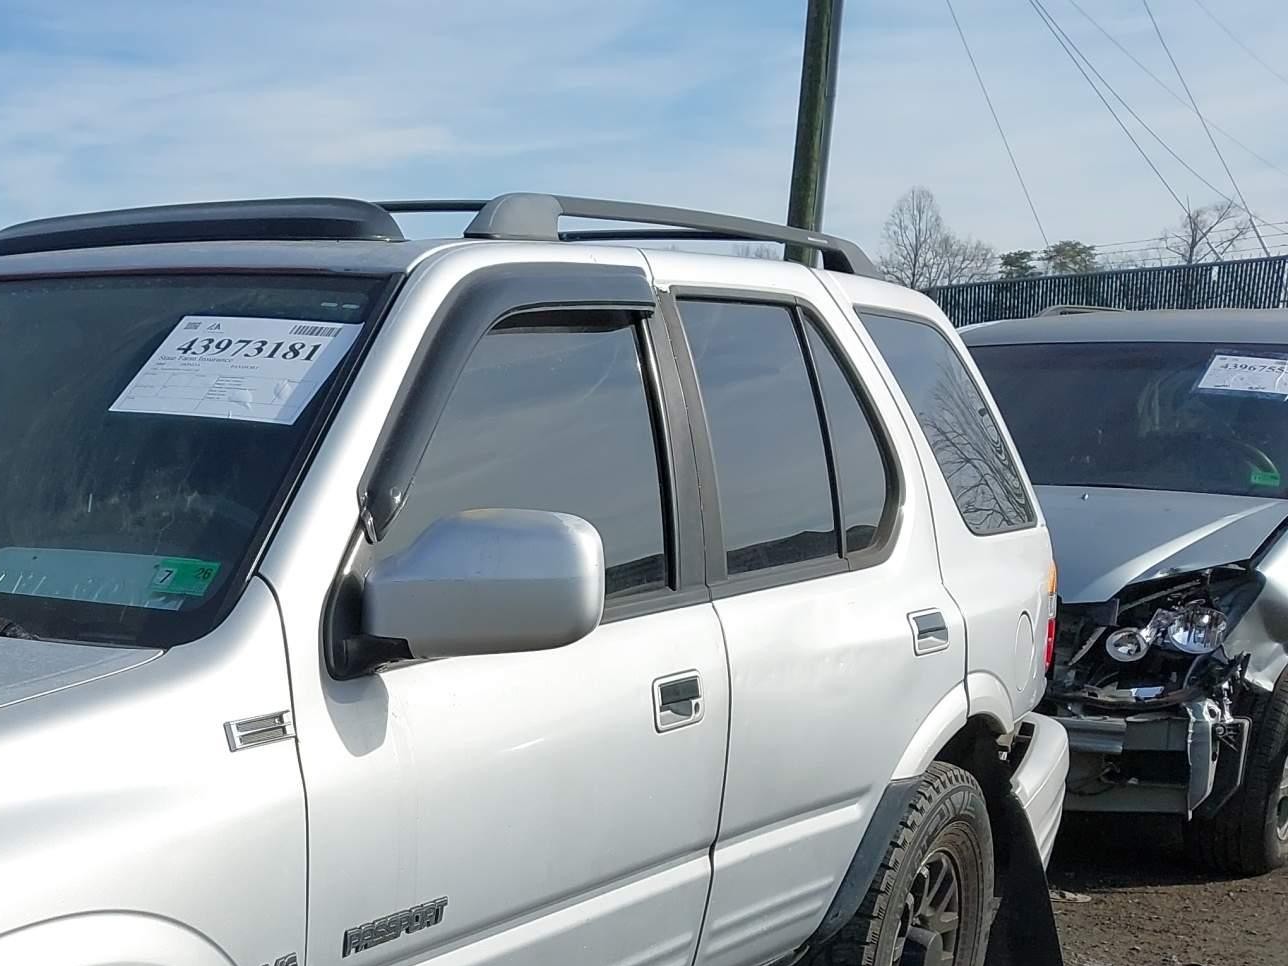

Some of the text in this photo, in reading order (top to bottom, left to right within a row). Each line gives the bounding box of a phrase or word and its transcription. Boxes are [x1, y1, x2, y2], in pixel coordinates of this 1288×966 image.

[176, 336, 322, 362] 43973181
[159, 569, 174, 584] 7
[342, 896, 449, 959] PASSPORT
